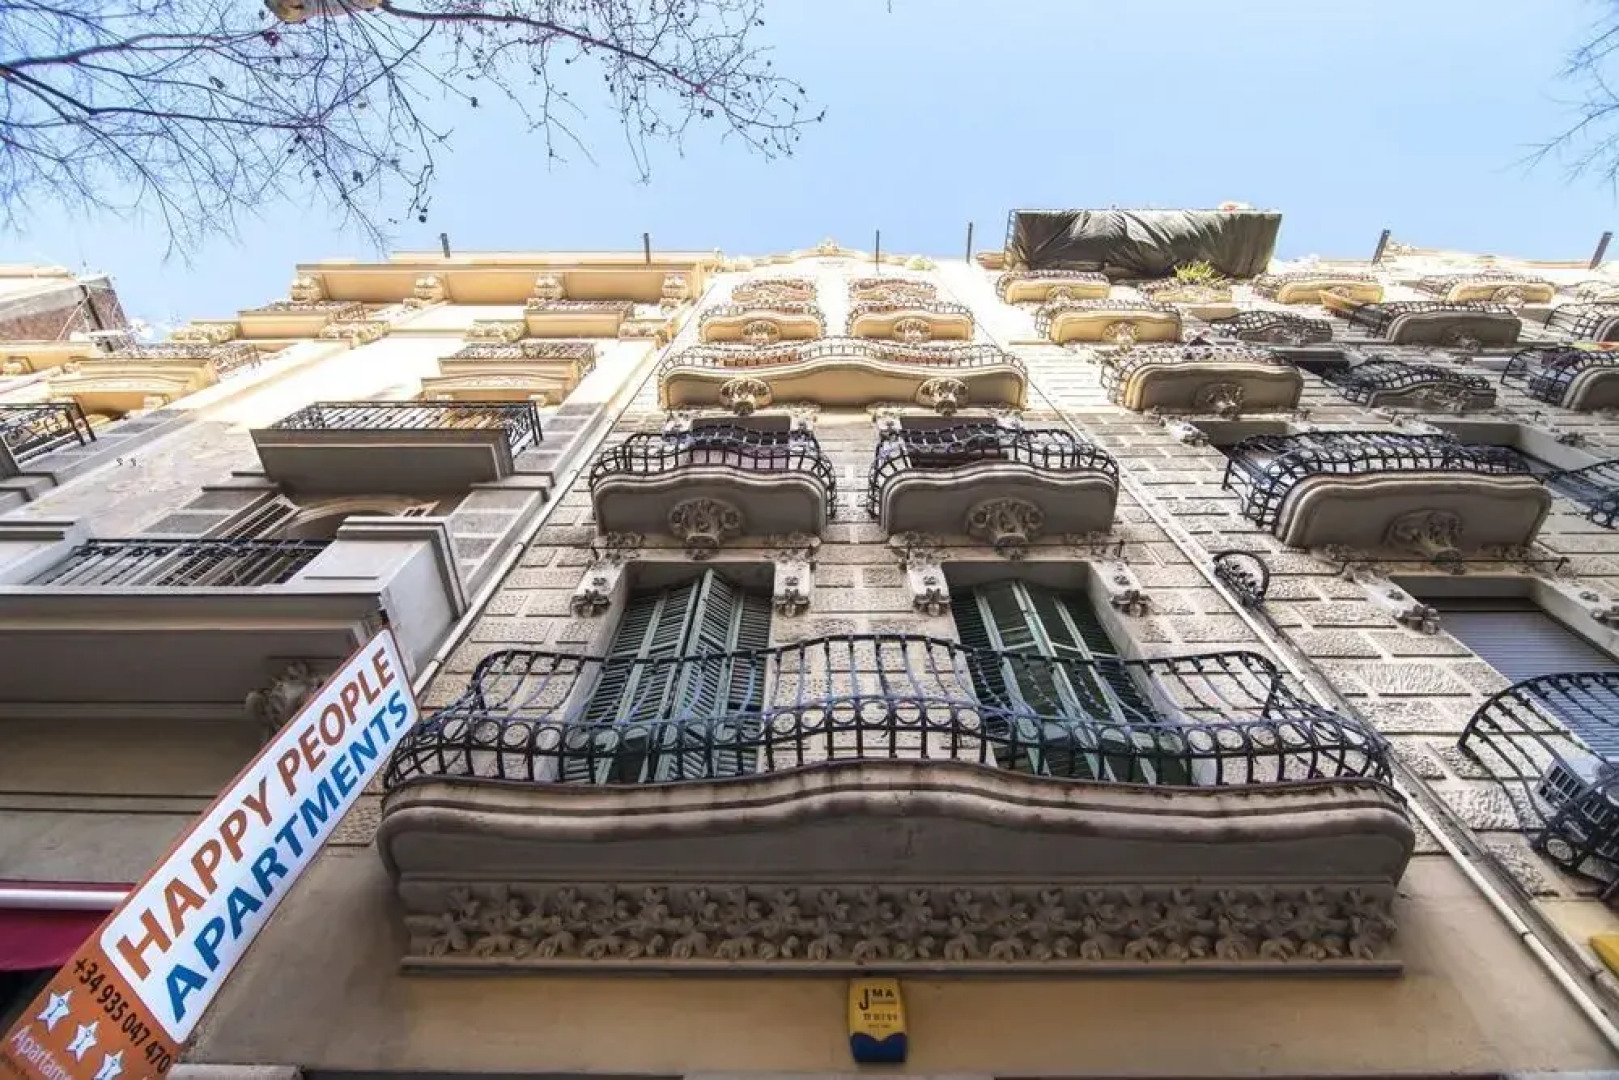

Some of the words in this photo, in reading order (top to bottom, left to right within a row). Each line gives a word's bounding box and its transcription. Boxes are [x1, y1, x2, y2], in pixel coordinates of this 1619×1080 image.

[116, 776, 272, 981] HAPPY
[276, 647, 396, 797] PEOPLE
[166, 689, 409, 1024] APARTMENTS
[73, 958, 106, 994] +34
[97, 984, 130, 1021] 935
[121, 1012, 150, 1047] 047
[144, 1041, 171, 1074] 470
